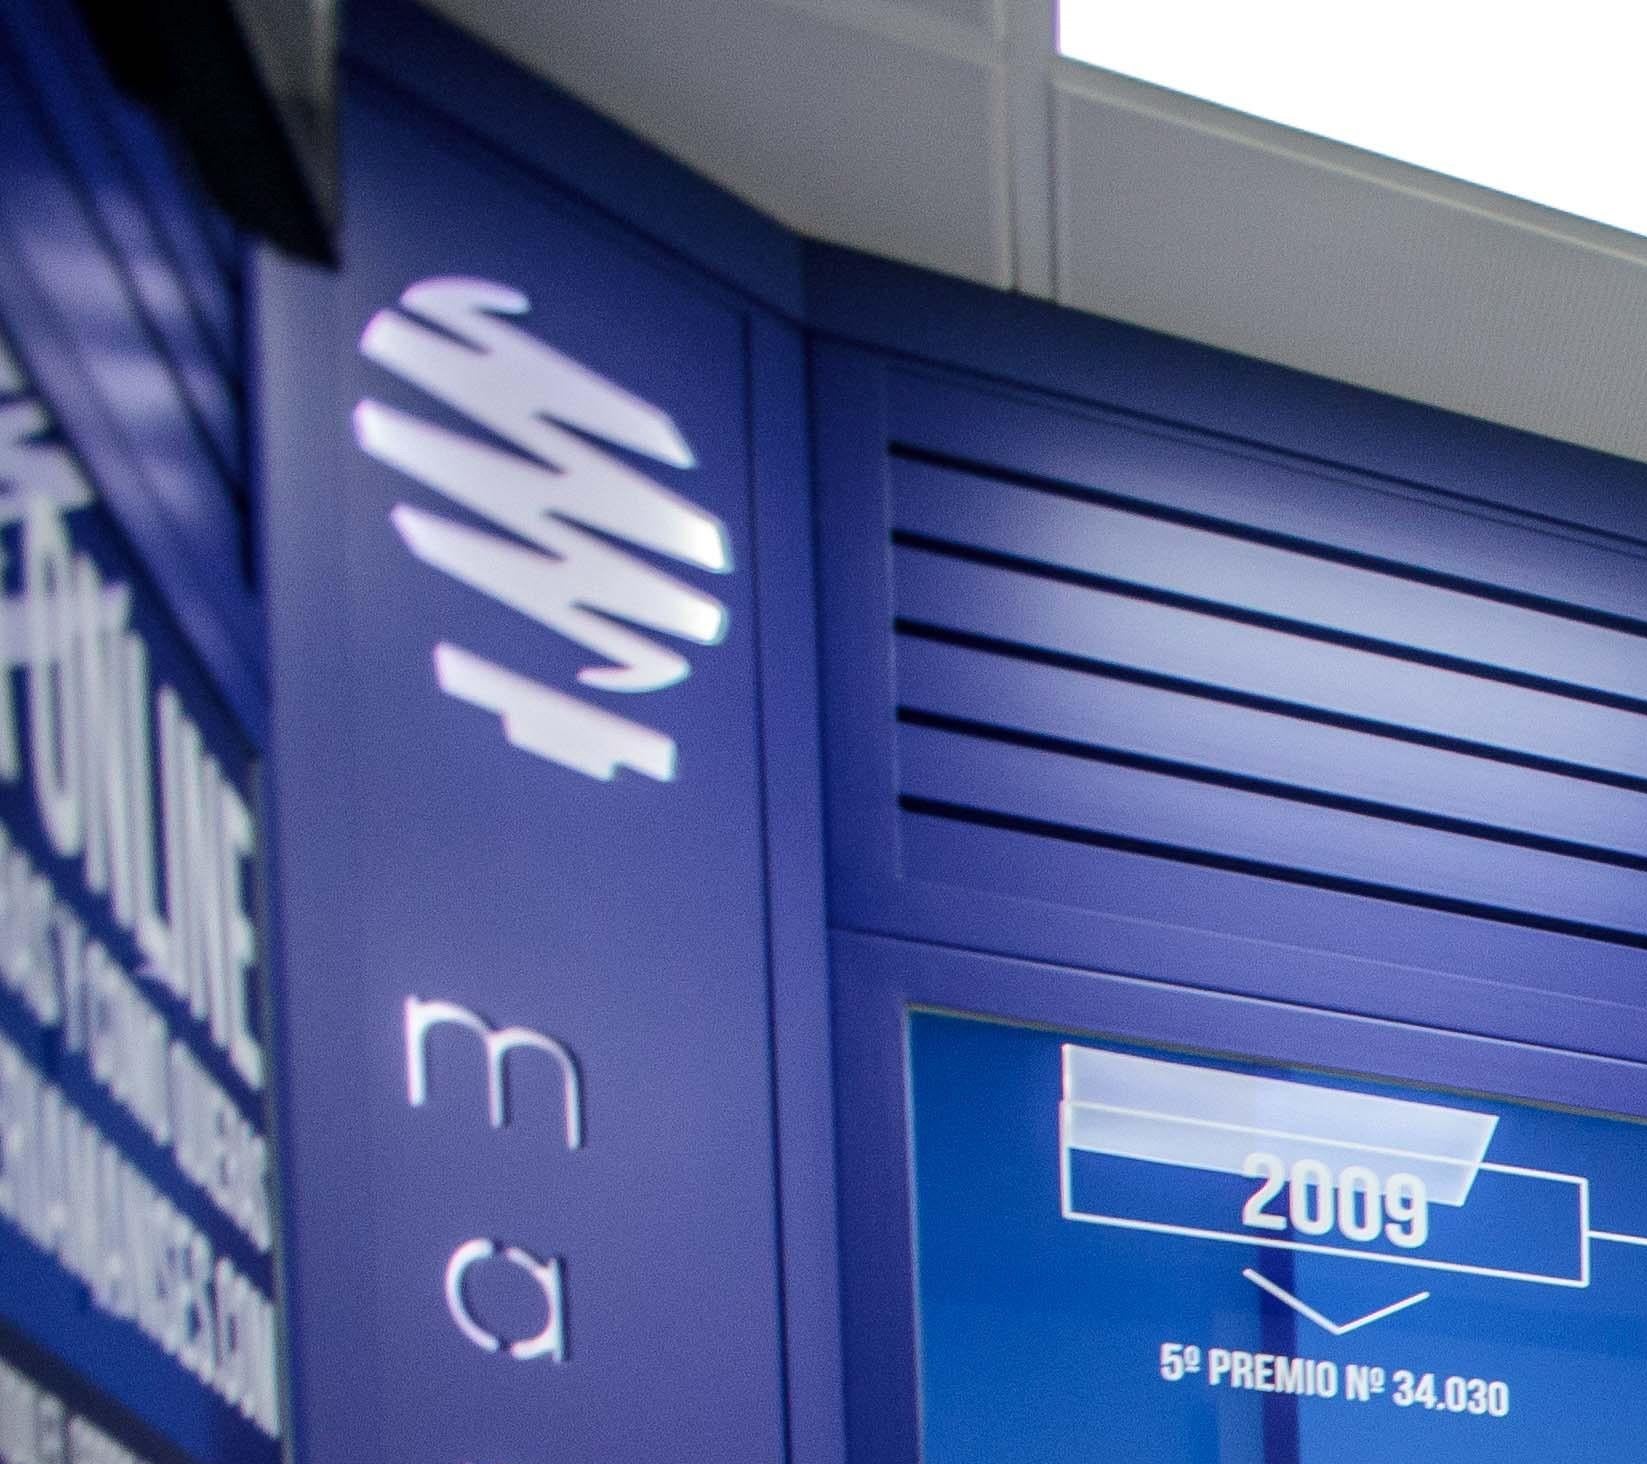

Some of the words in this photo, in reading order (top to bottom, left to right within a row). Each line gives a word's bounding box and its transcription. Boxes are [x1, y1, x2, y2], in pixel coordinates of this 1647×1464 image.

[1241, 1152, 1429, 1249] 2009
[1159, 1342, 1201, 1382] 5º
[1208, 1349, 1337, 1399] PREMIO
[1345, 1362, 1385, 1403] Nº
[1392, 1370, 1510, 1417] 34.030
